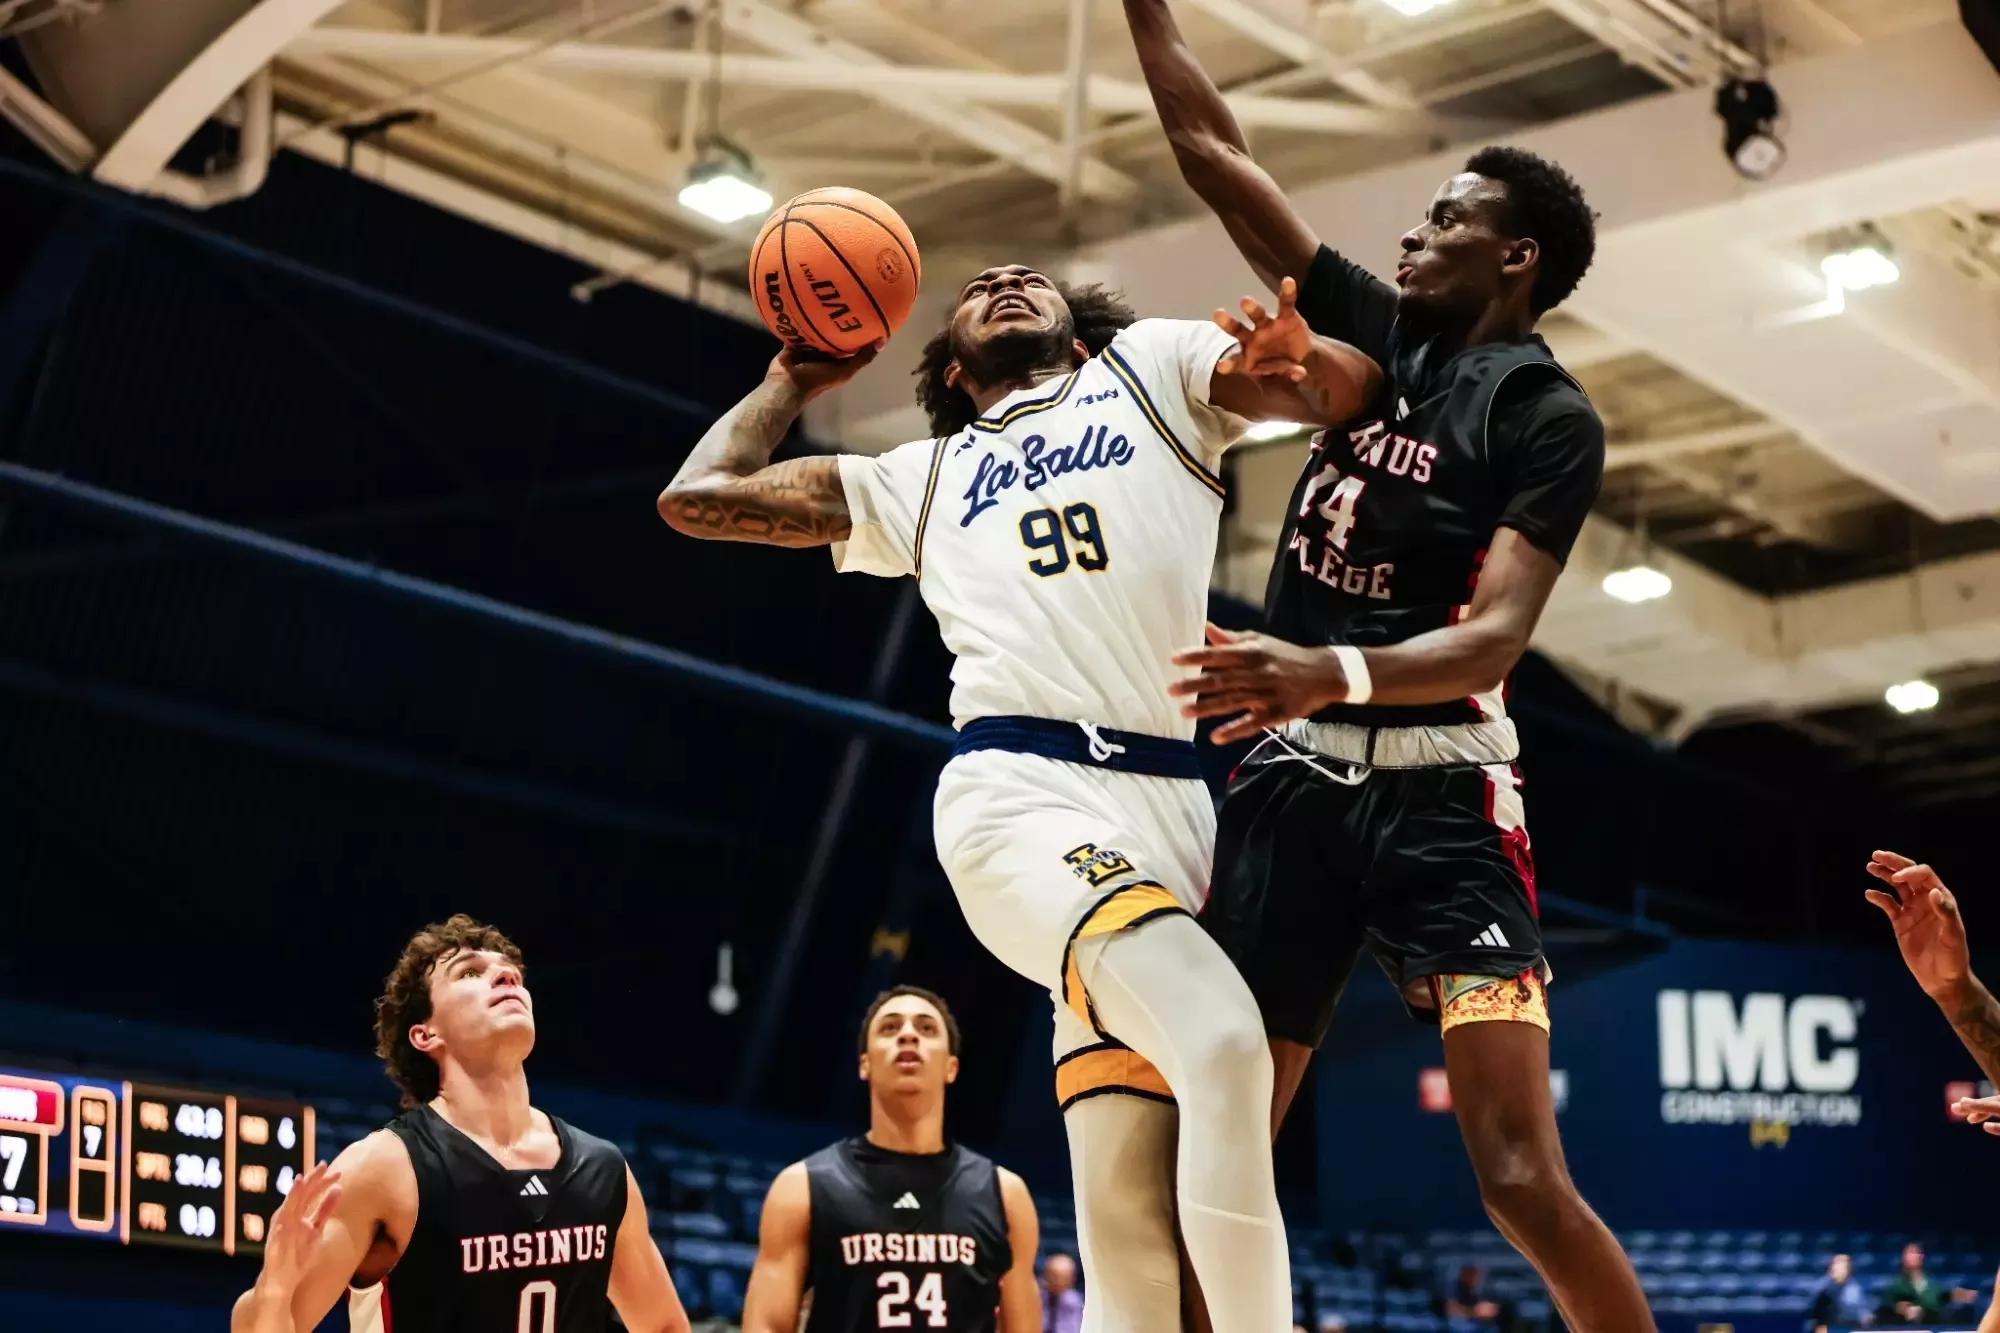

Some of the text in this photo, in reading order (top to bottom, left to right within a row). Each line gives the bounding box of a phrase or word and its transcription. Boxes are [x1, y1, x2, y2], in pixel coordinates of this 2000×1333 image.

[765, 271, 807, 344] ilson
[960, 425, 1136, 528] La Salle
[1018, 501, 1110, 579] 99
[1657, 988, 1860, 1092] IMC
[460, 1224, 608, 1273] URSINUS
[841, 1232, 977, 1266] URSINUS
[876, 1271, 948, 1329] 24
